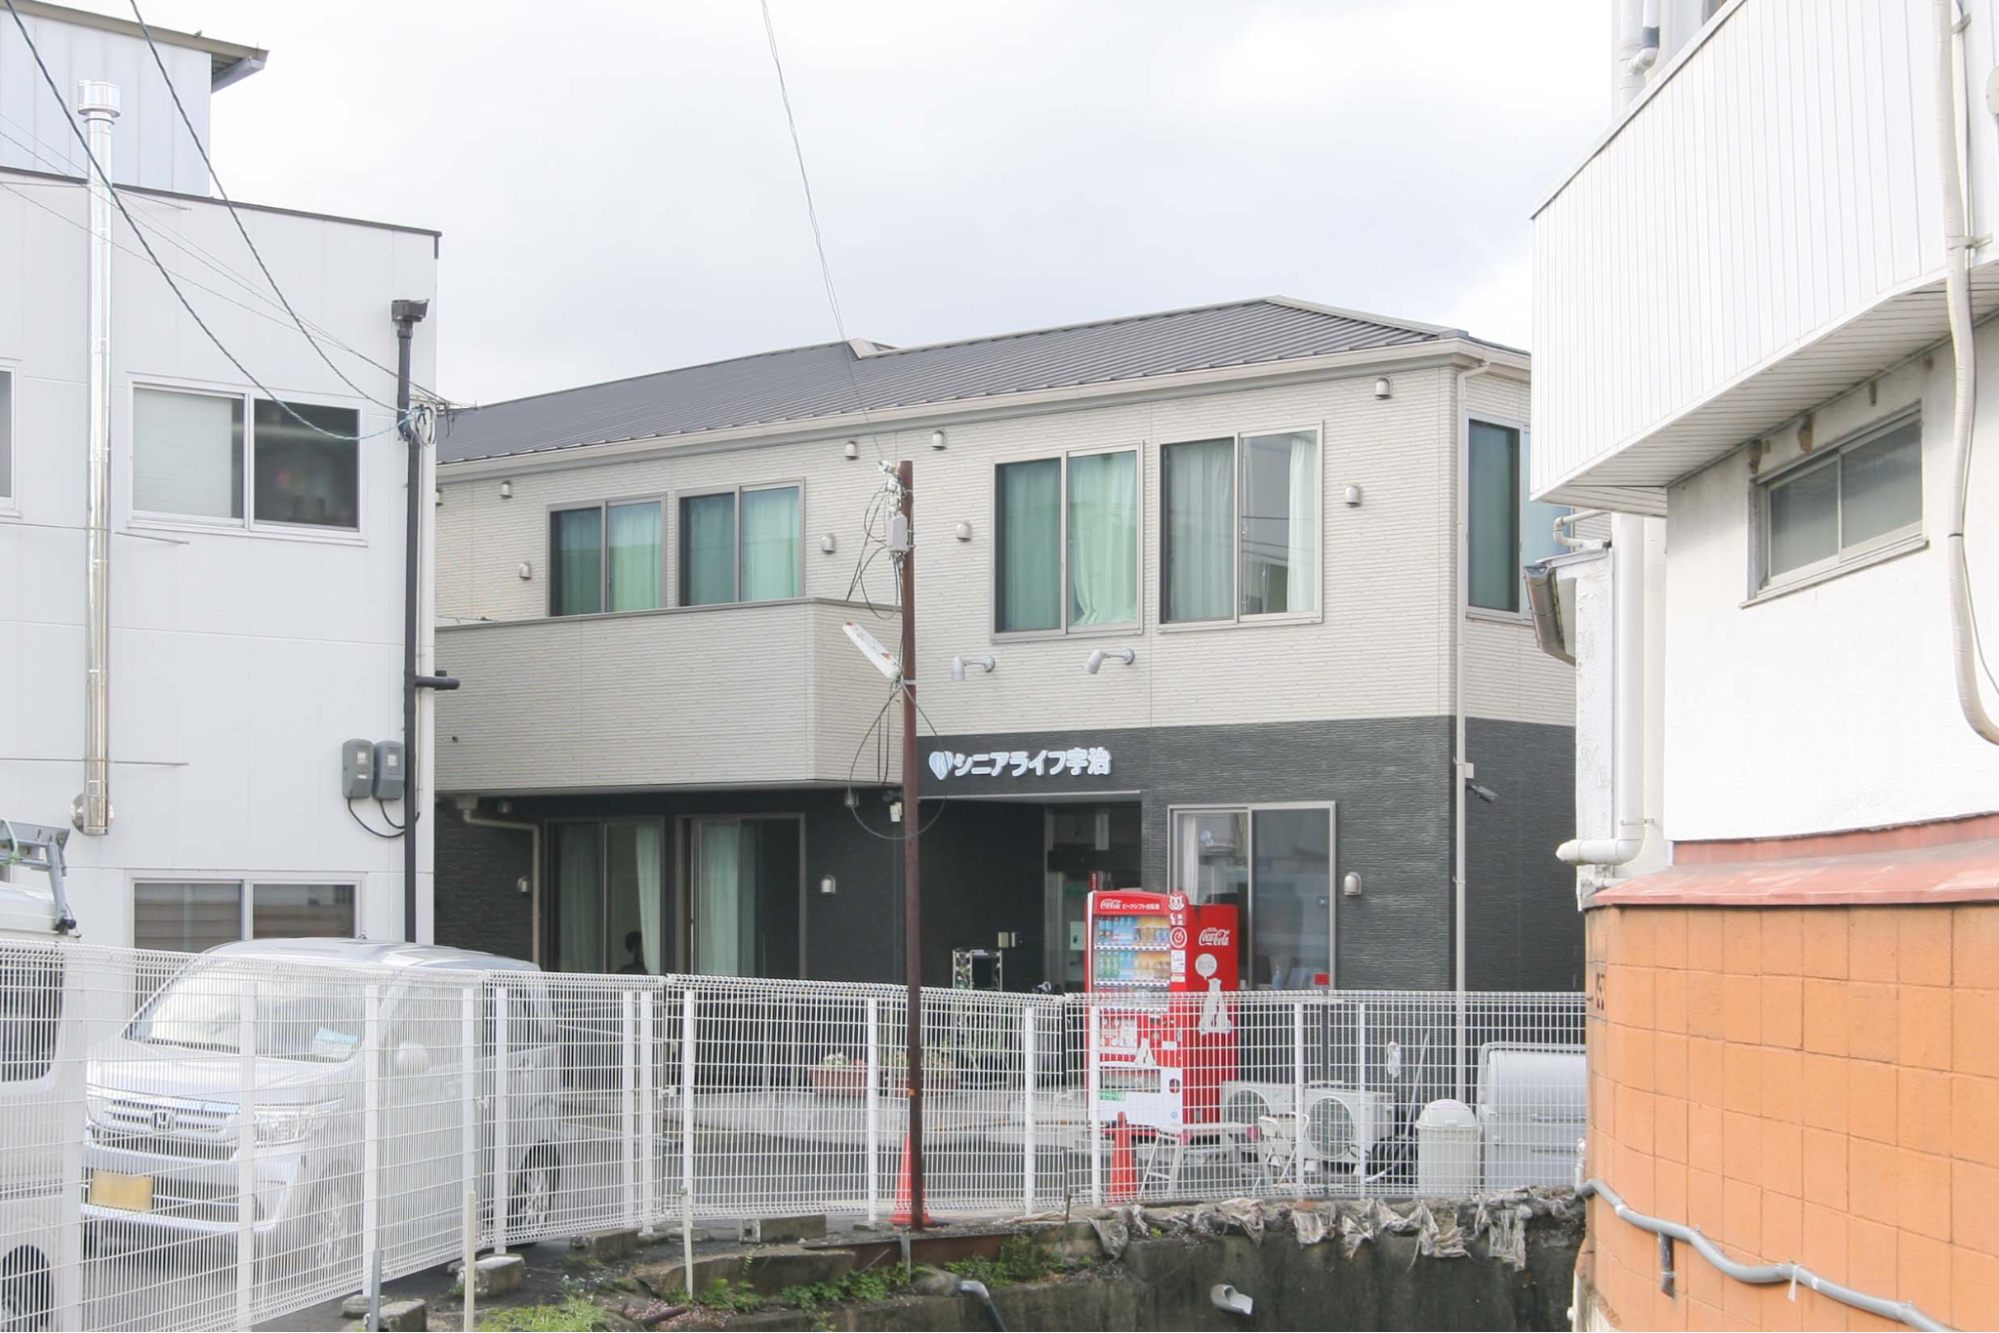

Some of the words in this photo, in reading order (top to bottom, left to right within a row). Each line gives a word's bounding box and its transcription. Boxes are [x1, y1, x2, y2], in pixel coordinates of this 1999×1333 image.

[953, 746, 1111, 777] シニアライフ宇治
